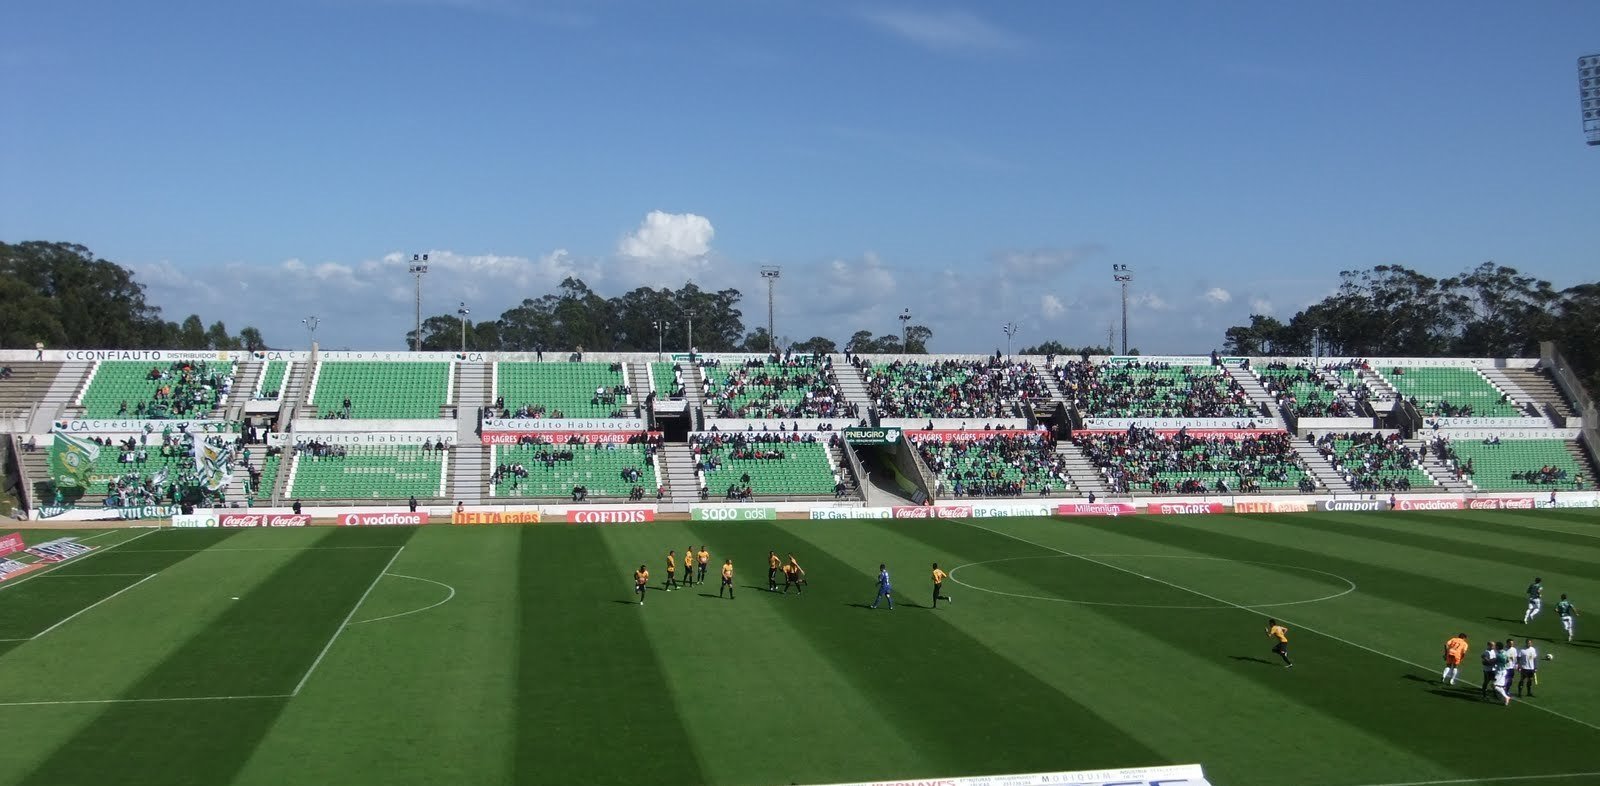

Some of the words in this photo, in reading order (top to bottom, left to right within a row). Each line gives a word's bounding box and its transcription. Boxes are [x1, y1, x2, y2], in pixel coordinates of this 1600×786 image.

[76, 351, 161, 360] CONFIAUTO
[267, 352, 283, 361] CA
[468, 353, 483, 361] CA
[71, 420, 90, 431] CA
[493, 419, 505, 427] CA
[508, 420, 562, 429] Crédito
[568, 420, 641, 430] Habitação
[1264, 418, 1273, 426] CA
[295, 434, 360, 442] Crédito
[491, 435, 517, 443] SAGRES
[599, 435, 625, 443] SAGRES
[1075, 504, 1120, 513] Millennium
[1325, 500, 1379, 511] Camport
[1413, 499, 1458, 509] vodafone
[974, 508, 987, 517] BP
[990, 508, 1008, 517] Gas
[1173, 505, 1211, 514] SAGRES
[363, 514, 420, 524] vodafone
[455, 512, 502, 523] DELTA
[505, 512, 538, 523] cafés
[574, 510, 646, 523] COFIDIS
[701, 508, 737, 521] sapo
[744, 508, 767, 519] adsl
[812, 511, 825, 519] BP
[828, 511, 847, 519] Gas
[1042, 773, 1111, 783] MOBIQUIM
